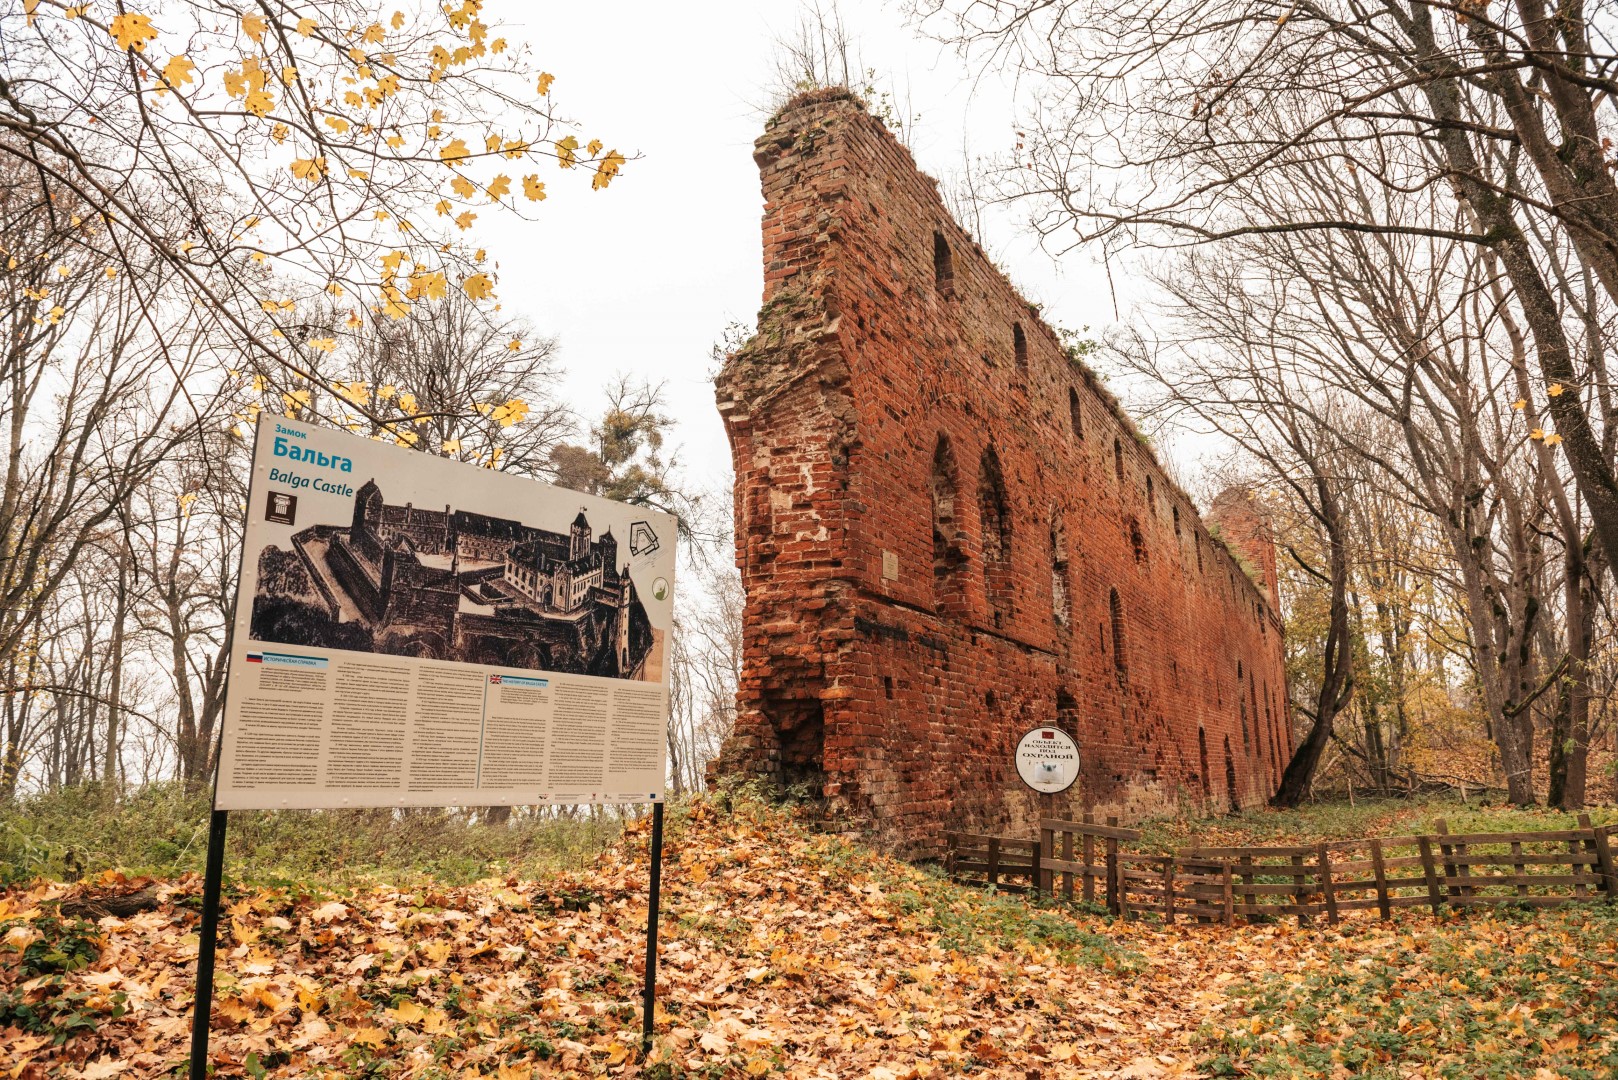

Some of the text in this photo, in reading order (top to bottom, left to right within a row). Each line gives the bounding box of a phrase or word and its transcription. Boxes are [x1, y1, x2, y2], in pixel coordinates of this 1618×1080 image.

[275, 424, 307, 439] Замок
[273, 436, 352, 473] Бальга
[269, 468, 354, 498] Balga Castle
